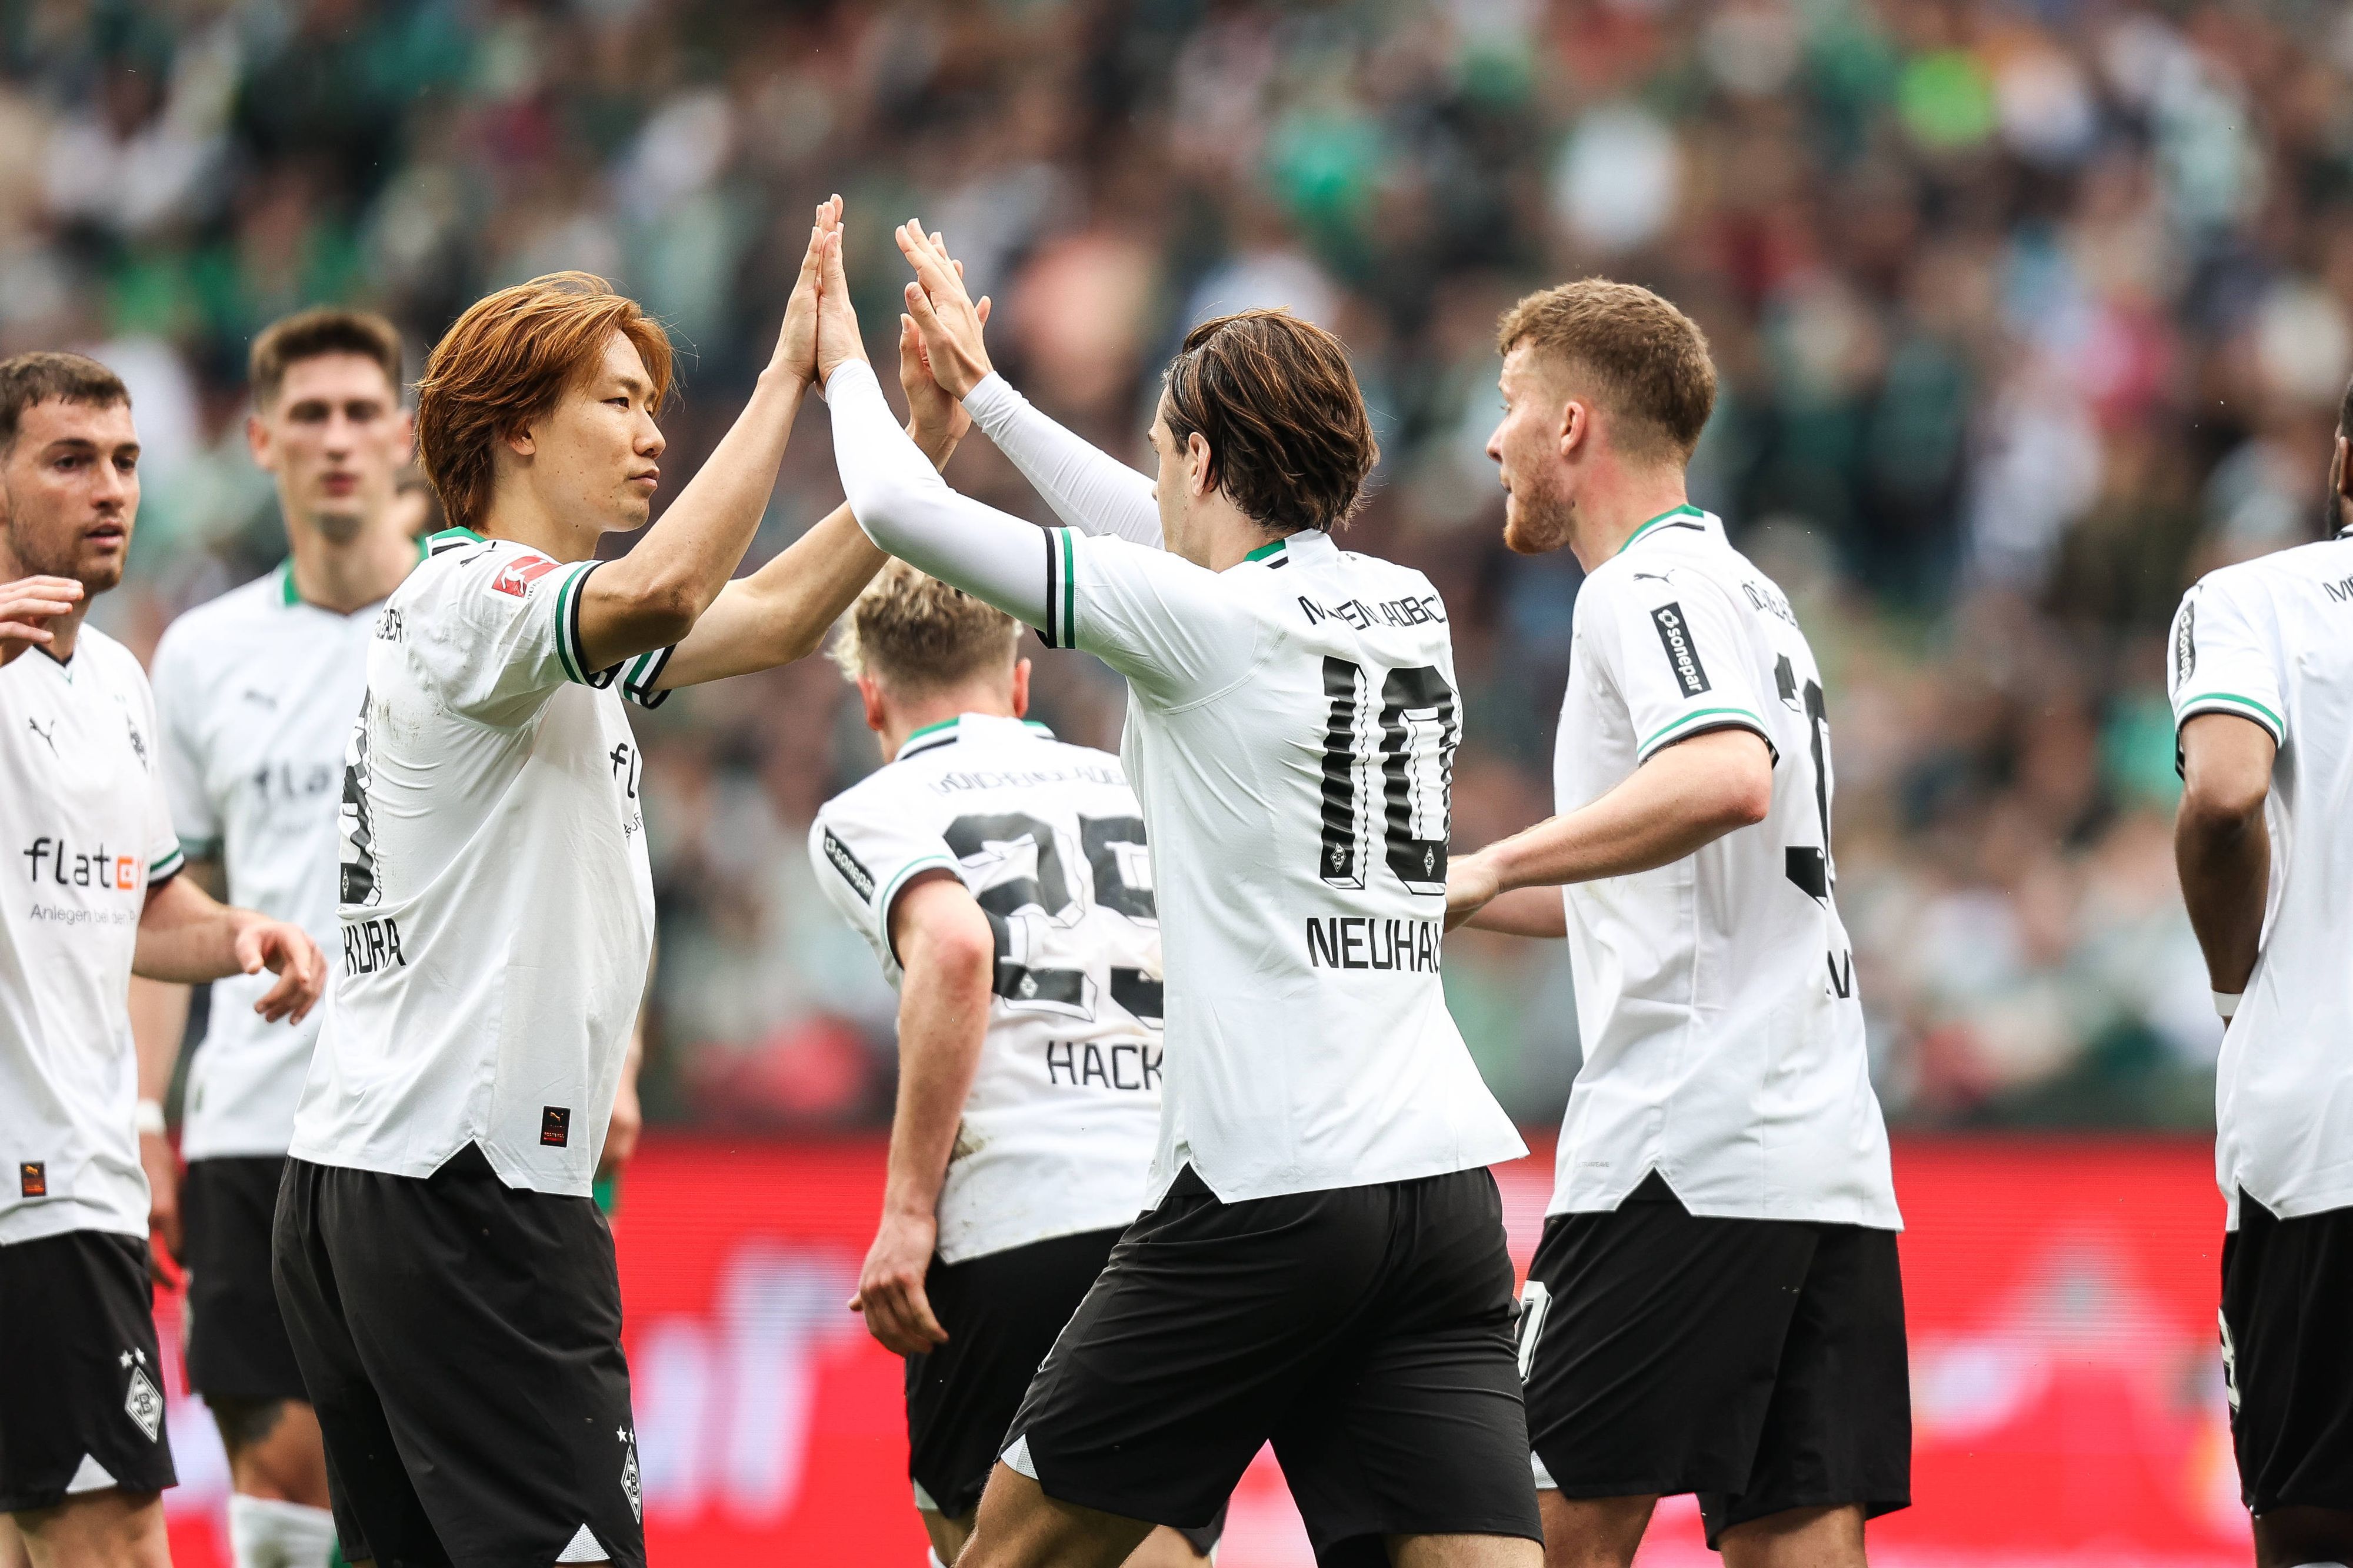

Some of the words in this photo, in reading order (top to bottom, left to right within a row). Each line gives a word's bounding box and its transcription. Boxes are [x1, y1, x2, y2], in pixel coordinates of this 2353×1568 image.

[1667, 627, 1703, 691] sonepar
[1321, 655, 1460, 896] 10
[31, 903, 92, 925] Anlegen
[942, 810, 1164, 1028] 25
[1047, 1040, 1163, 1090] HACK
